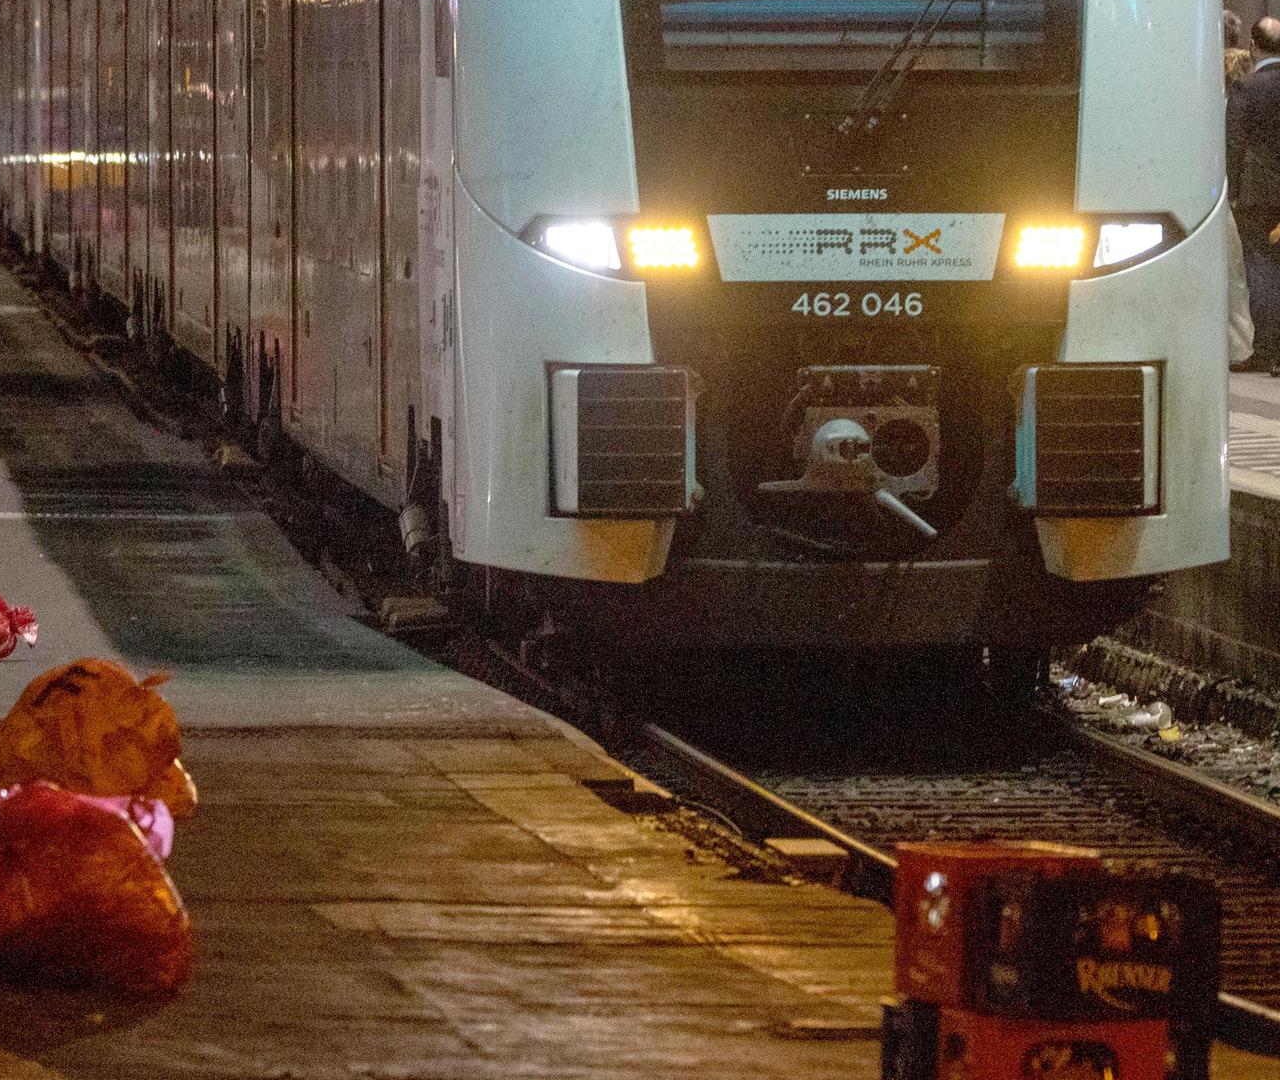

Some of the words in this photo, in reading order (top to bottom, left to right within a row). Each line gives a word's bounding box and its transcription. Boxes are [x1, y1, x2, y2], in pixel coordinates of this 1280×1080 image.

[826, 188, 888, 201] SIEMENS
[859, 258, 894, 268] RHEIN
[897, 258, 928, 268] RUHR
[930, 258, 972, 268] XPRESS
[791, 291, 851, 317] 462
[861, 291, 923, 317] 046
